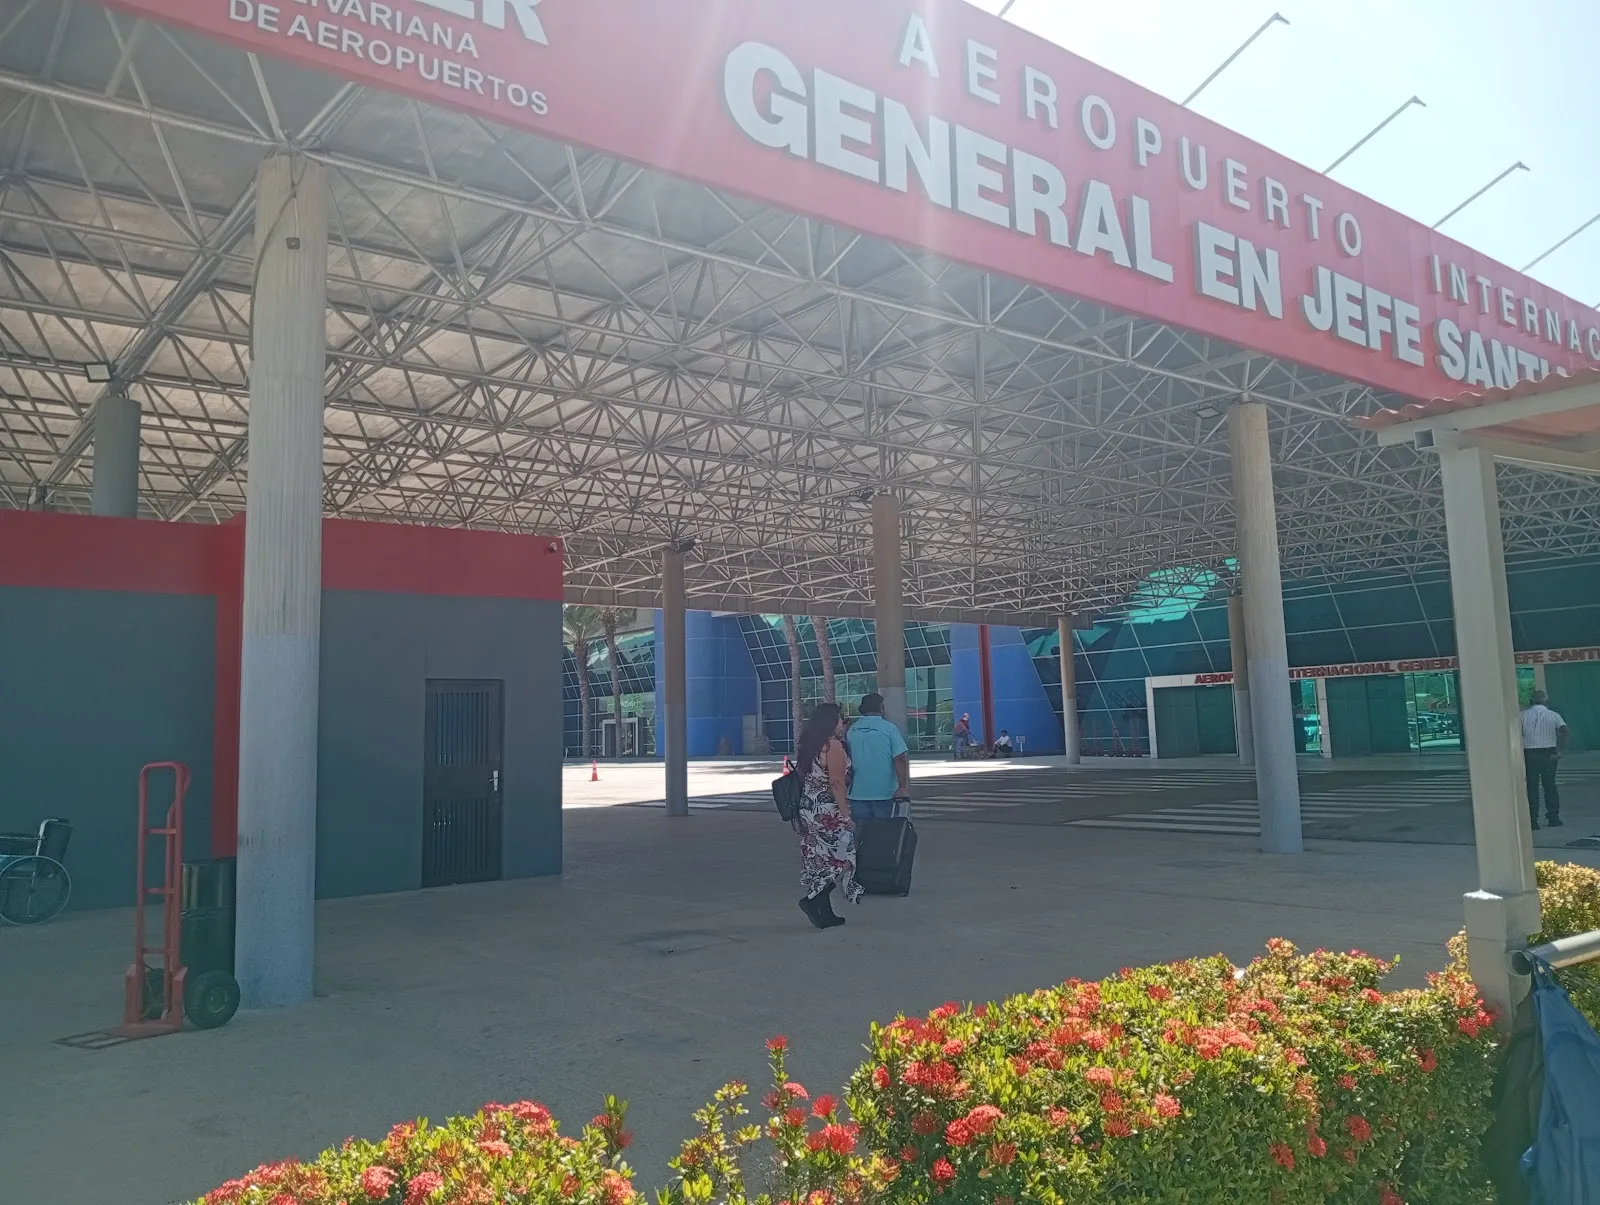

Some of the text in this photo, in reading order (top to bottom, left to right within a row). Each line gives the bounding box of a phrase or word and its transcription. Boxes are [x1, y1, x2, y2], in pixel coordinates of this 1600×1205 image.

[229, 0, 280, 33] DE
[286, 14, 549, 116] AEROPUERTOS
[898, 13, 1362, 257] AEROPUERTO
[723, 41, 1174, 284] GENERAL
[1195, 220, 1283, 320] EN
[1301, 265, 1424, 367] JEFE
